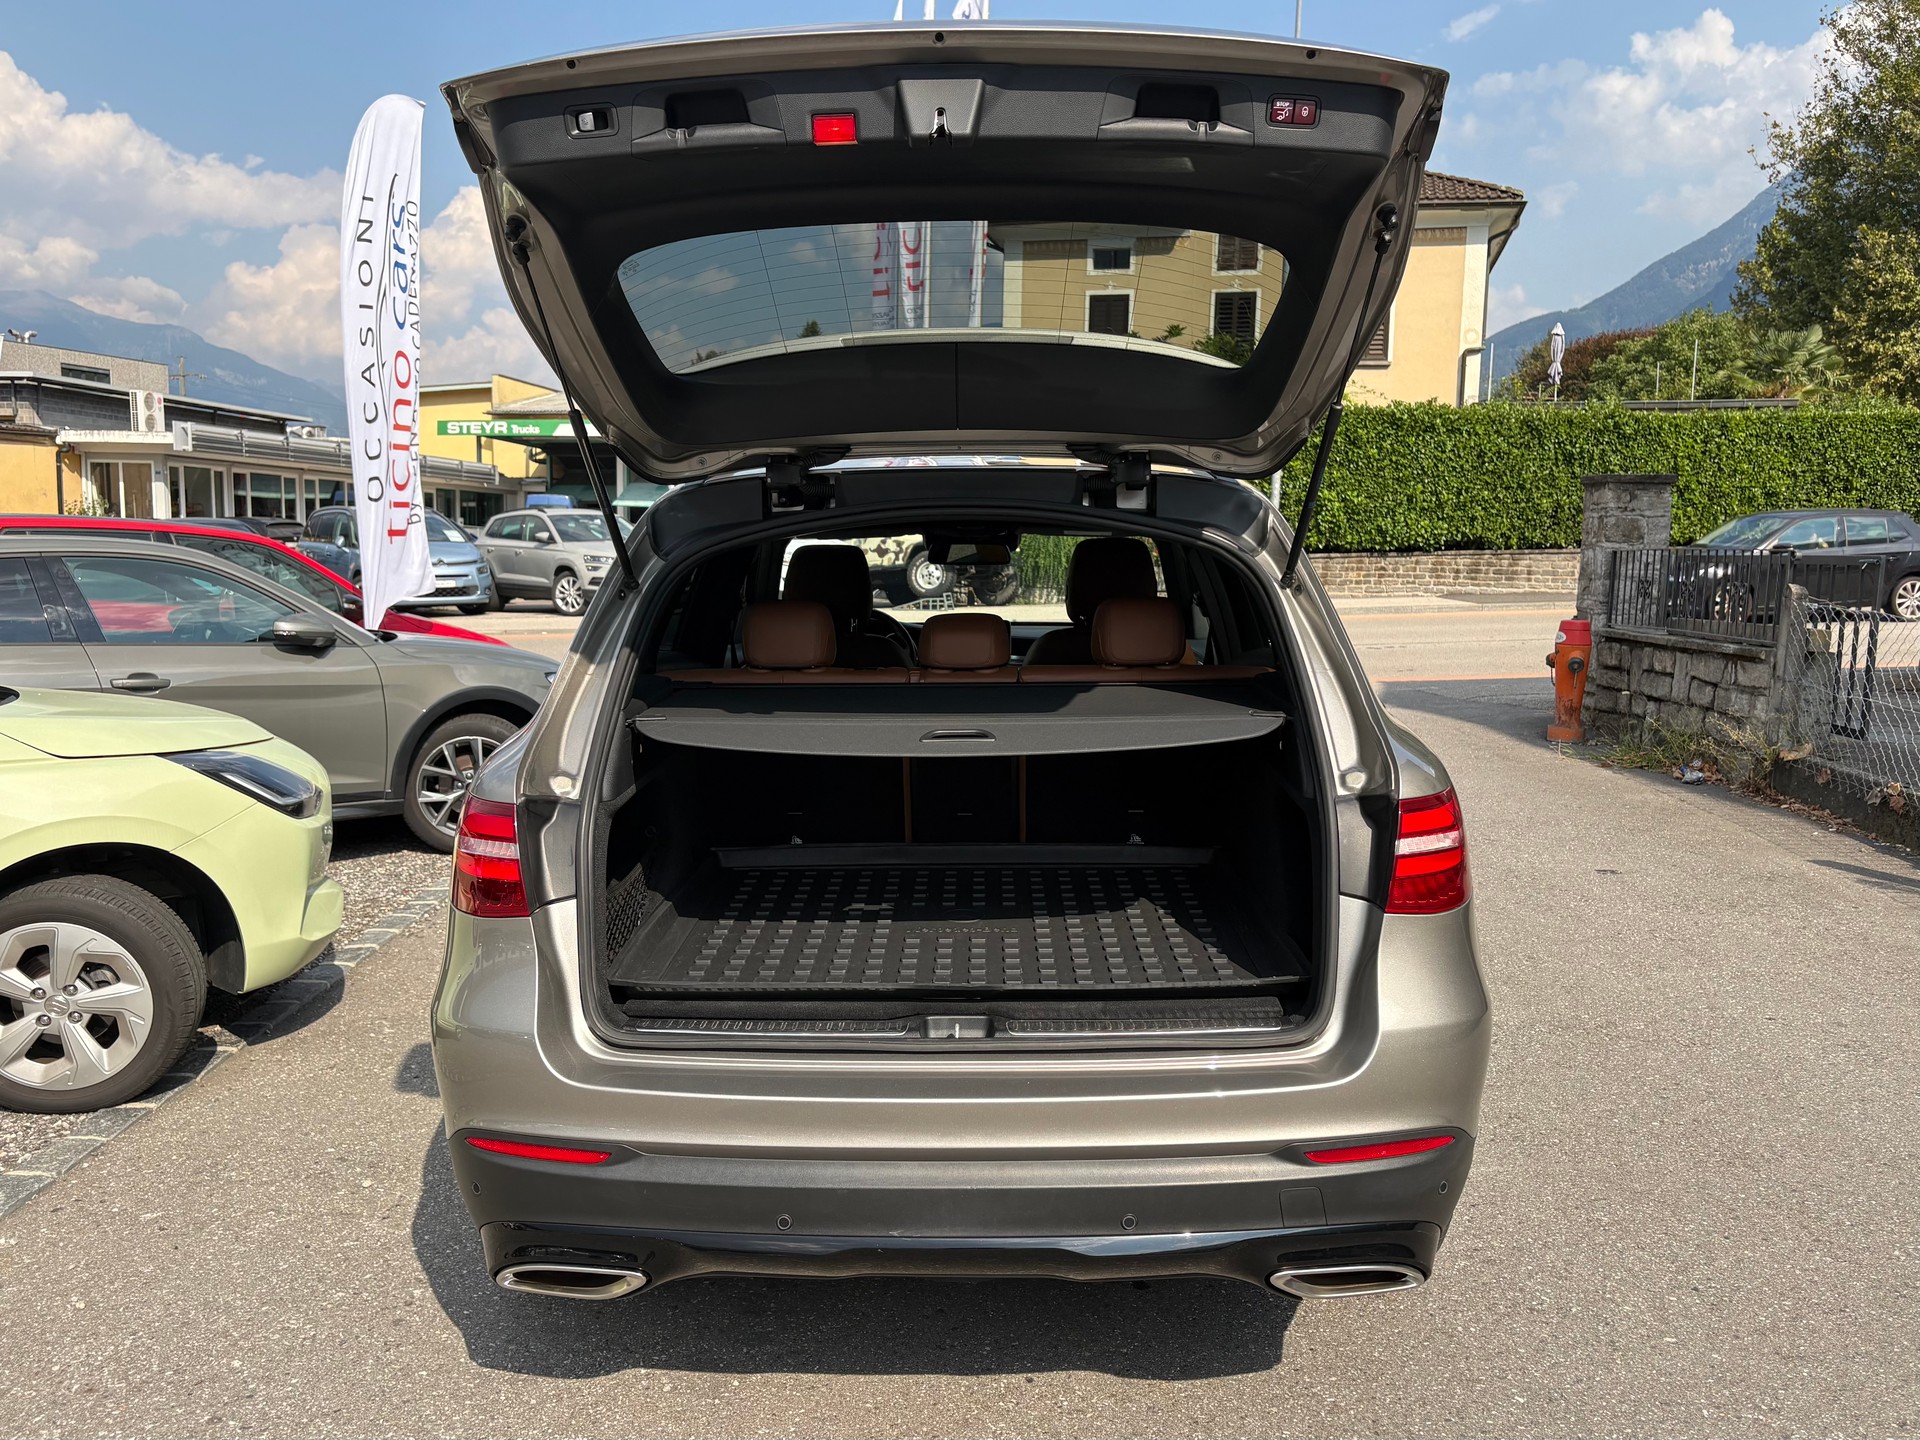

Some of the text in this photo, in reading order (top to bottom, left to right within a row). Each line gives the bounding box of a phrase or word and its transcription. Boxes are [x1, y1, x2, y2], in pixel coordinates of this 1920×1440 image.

[357, 195, 384, 502] OCCASIONI
[388, 202, 412, 544] ticino cars
[447, 421, 541, 434] STEYR Trucks
[407, 503, 422, 525] by
